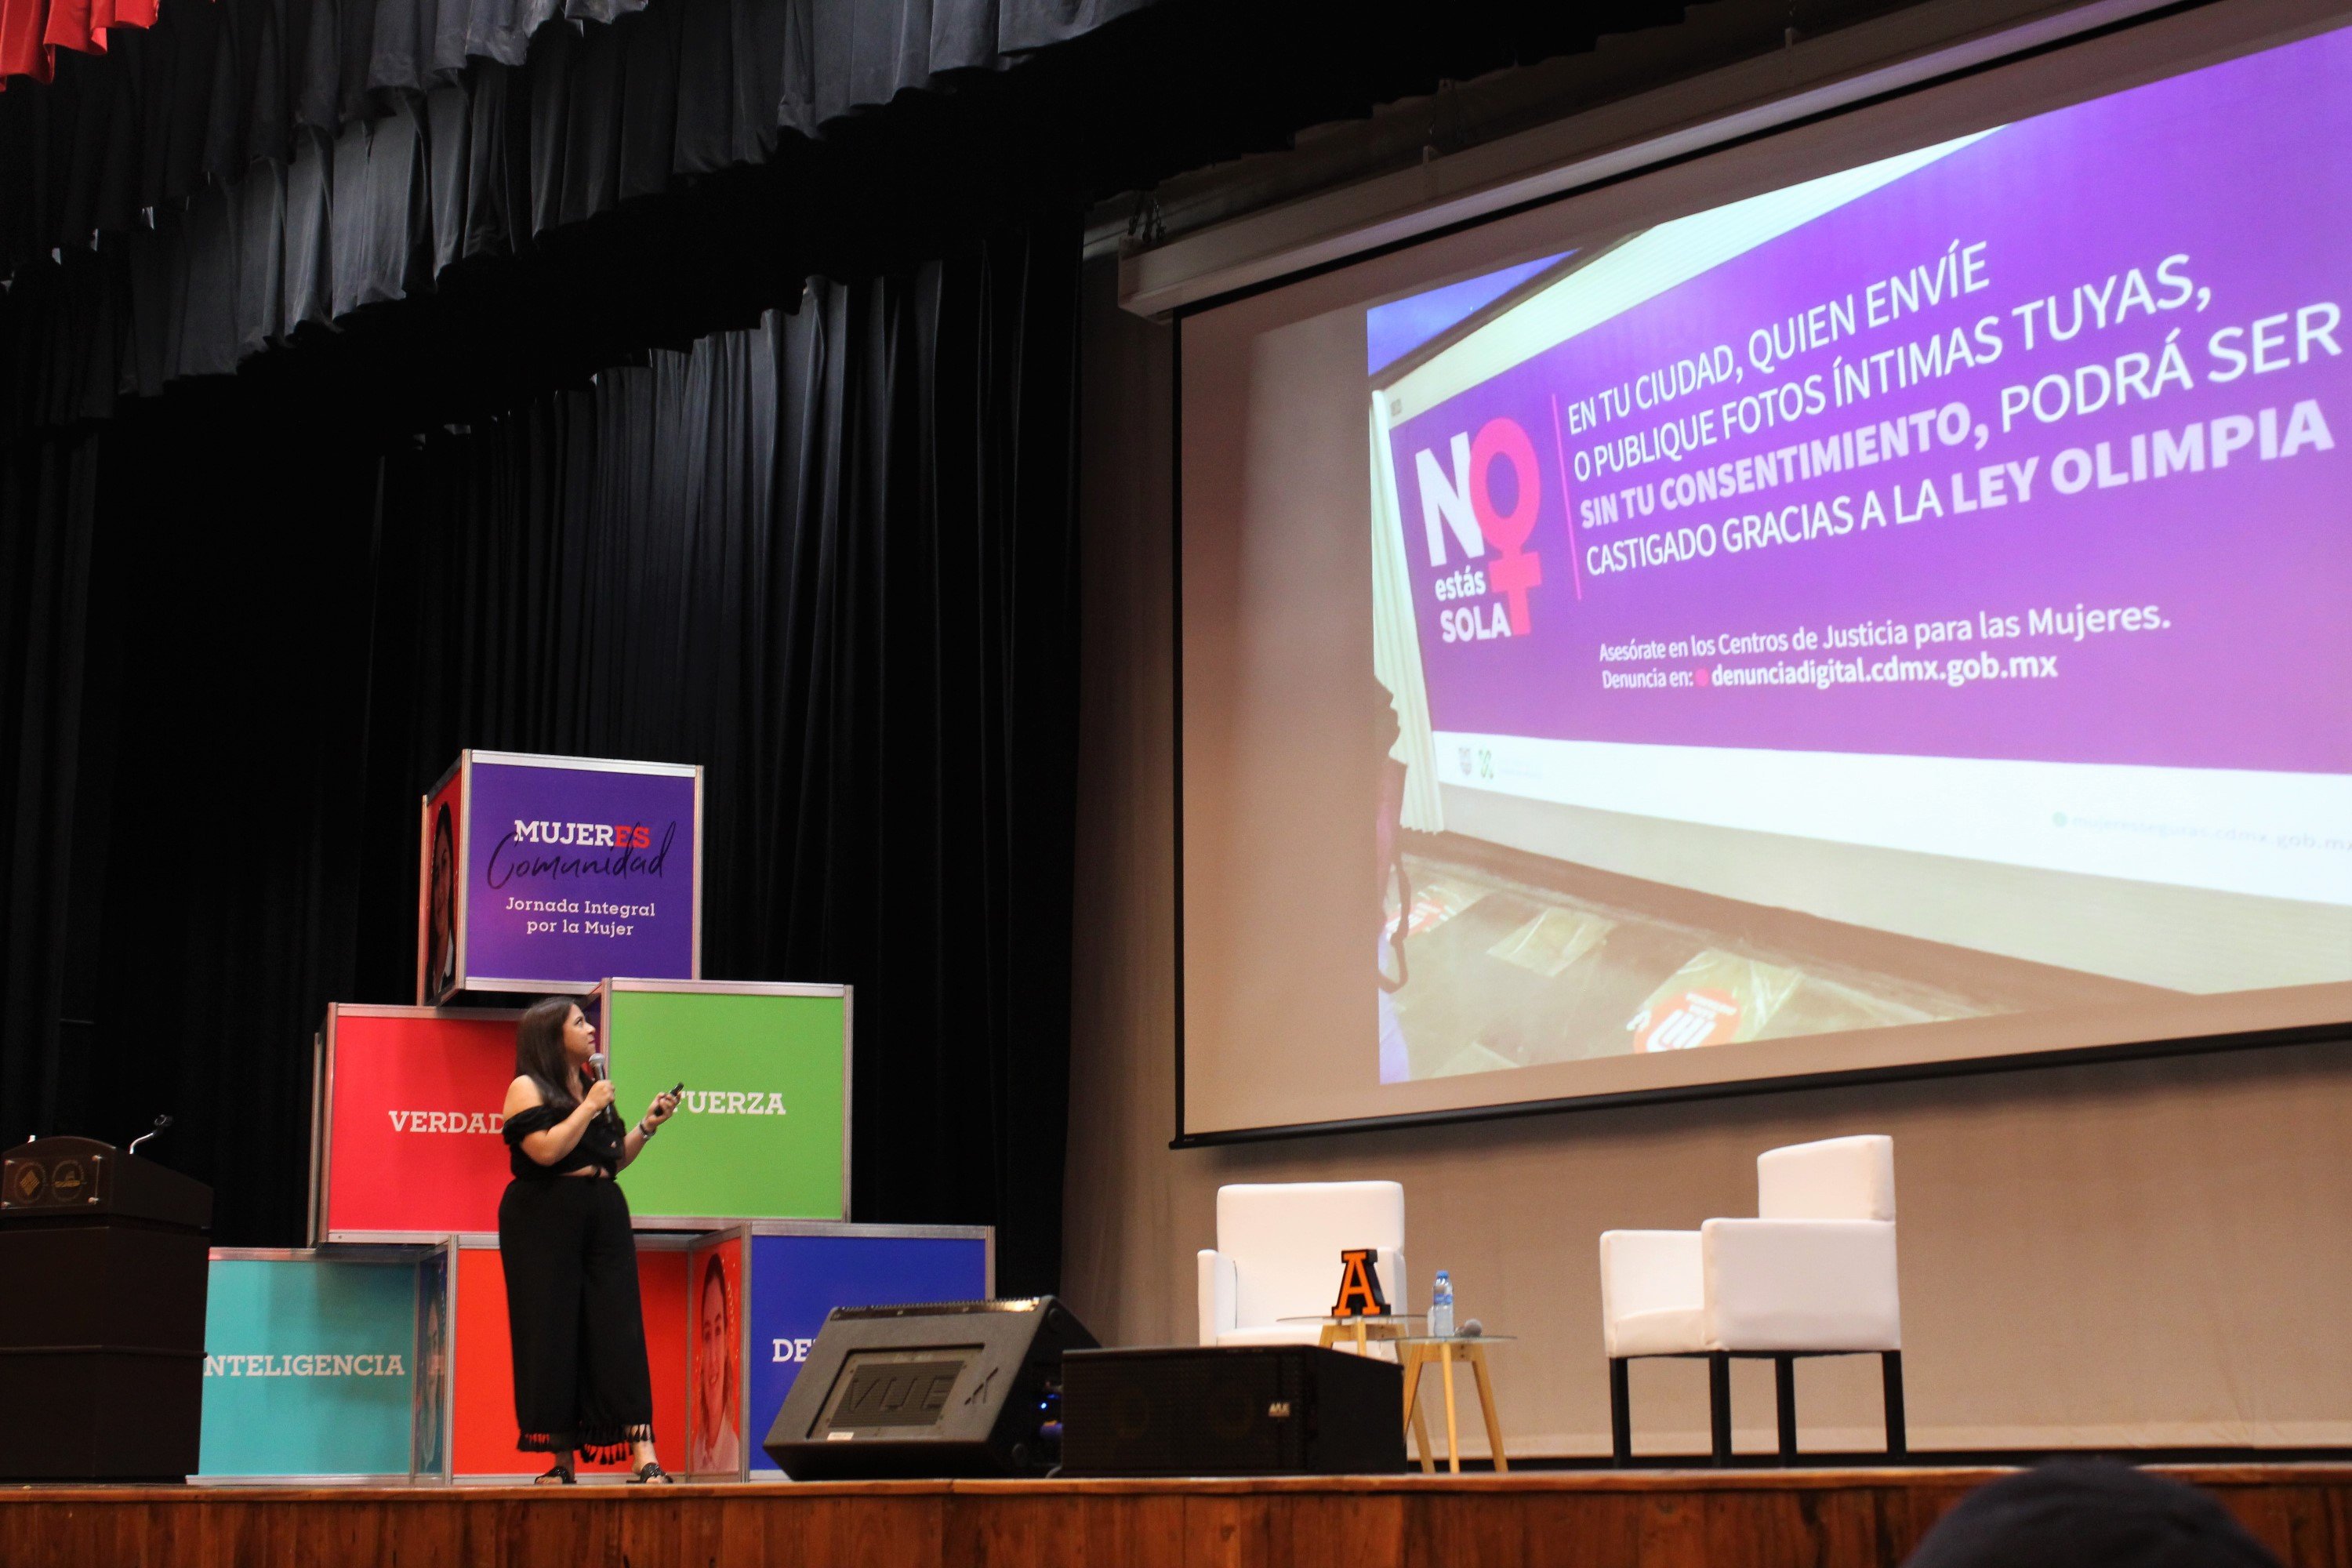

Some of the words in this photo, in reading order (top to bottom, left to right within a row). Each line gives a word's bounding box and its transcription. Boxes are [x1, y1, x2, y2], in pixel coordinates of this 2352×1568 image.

[1569, 397, 1596, 434] EN
[1599, 383, 1630, 422] TU
[1635, 345, 1743, 409] CIUDAD,
[1748, 294, 1855, 374] QUIEN
[1866, 239, 1989, 328] ENVÍE
[1574, 451, 1591, 481] O
[1594, 409, 1717, 477] PUBLIQUE
[1722, 375, 1826, 439] FOTOS
[1833, 316, 2002, 407] ÍNTIMAS
[2012, 254, 2211, 350] TUYAS,
[1581, 493, 1618, 528] SIN
[1621, 484, 1655, 519] TU
[1660, 401, 1988, 514] CONSENTIMIENTO,
[2002, 328, 2194, 433] PODRÁ
[2208, 303, 2342, 383] SER
[1587, 524, 1716, 575] CASTIGADO
[1722, 495, 1854, 553] GRACIAS
[1861, 490, 1886, 530] A
[1894, 479, 1944, 524] LA
[1951, 456, 2039, 514] LEY
[2051, 400, 2334, 494] OLIMPIA
[1436, 565, 1486, 601] estás
[1440, 603, 1512, 643] SOLA
[1599, 638, 1666, 662] Asesórate
[1668, 641, 1689, 658] en
[1691, 635, 1715, 656] los
[1719, 633, 1788, 655] Centros
[1792, 626, 1818, 651] de
[1823, 620, 1908, 649] Justicia
[1915, 615, 1973, 649] para
[1980, 611, 2020, 639] las
[2028, 604, 2170, 641] Mujeres.
[1602, 668, 1667, 688] Denuncia
[1669, 671, 1693, 688] en:
[1711, 652, 2058, 689] denunciadigital.cdmx.gob.mx
[514, 820, 651, 848] MUJERES
[488, 821, 676, 889] Comunidad
[506, 897, 579, 913] Jornada
[585, 901, 655, 918] Integral
[527, 921, 557, 934] por
[563, 920, 579, 933] la
[585, 921, 633, 938] Mujer
[389, 1110, 504, 1134] VERDAD
[204, 1355, 405, 1376] NTELIGENCIA
[772, 1338, 816, 1362] DE
